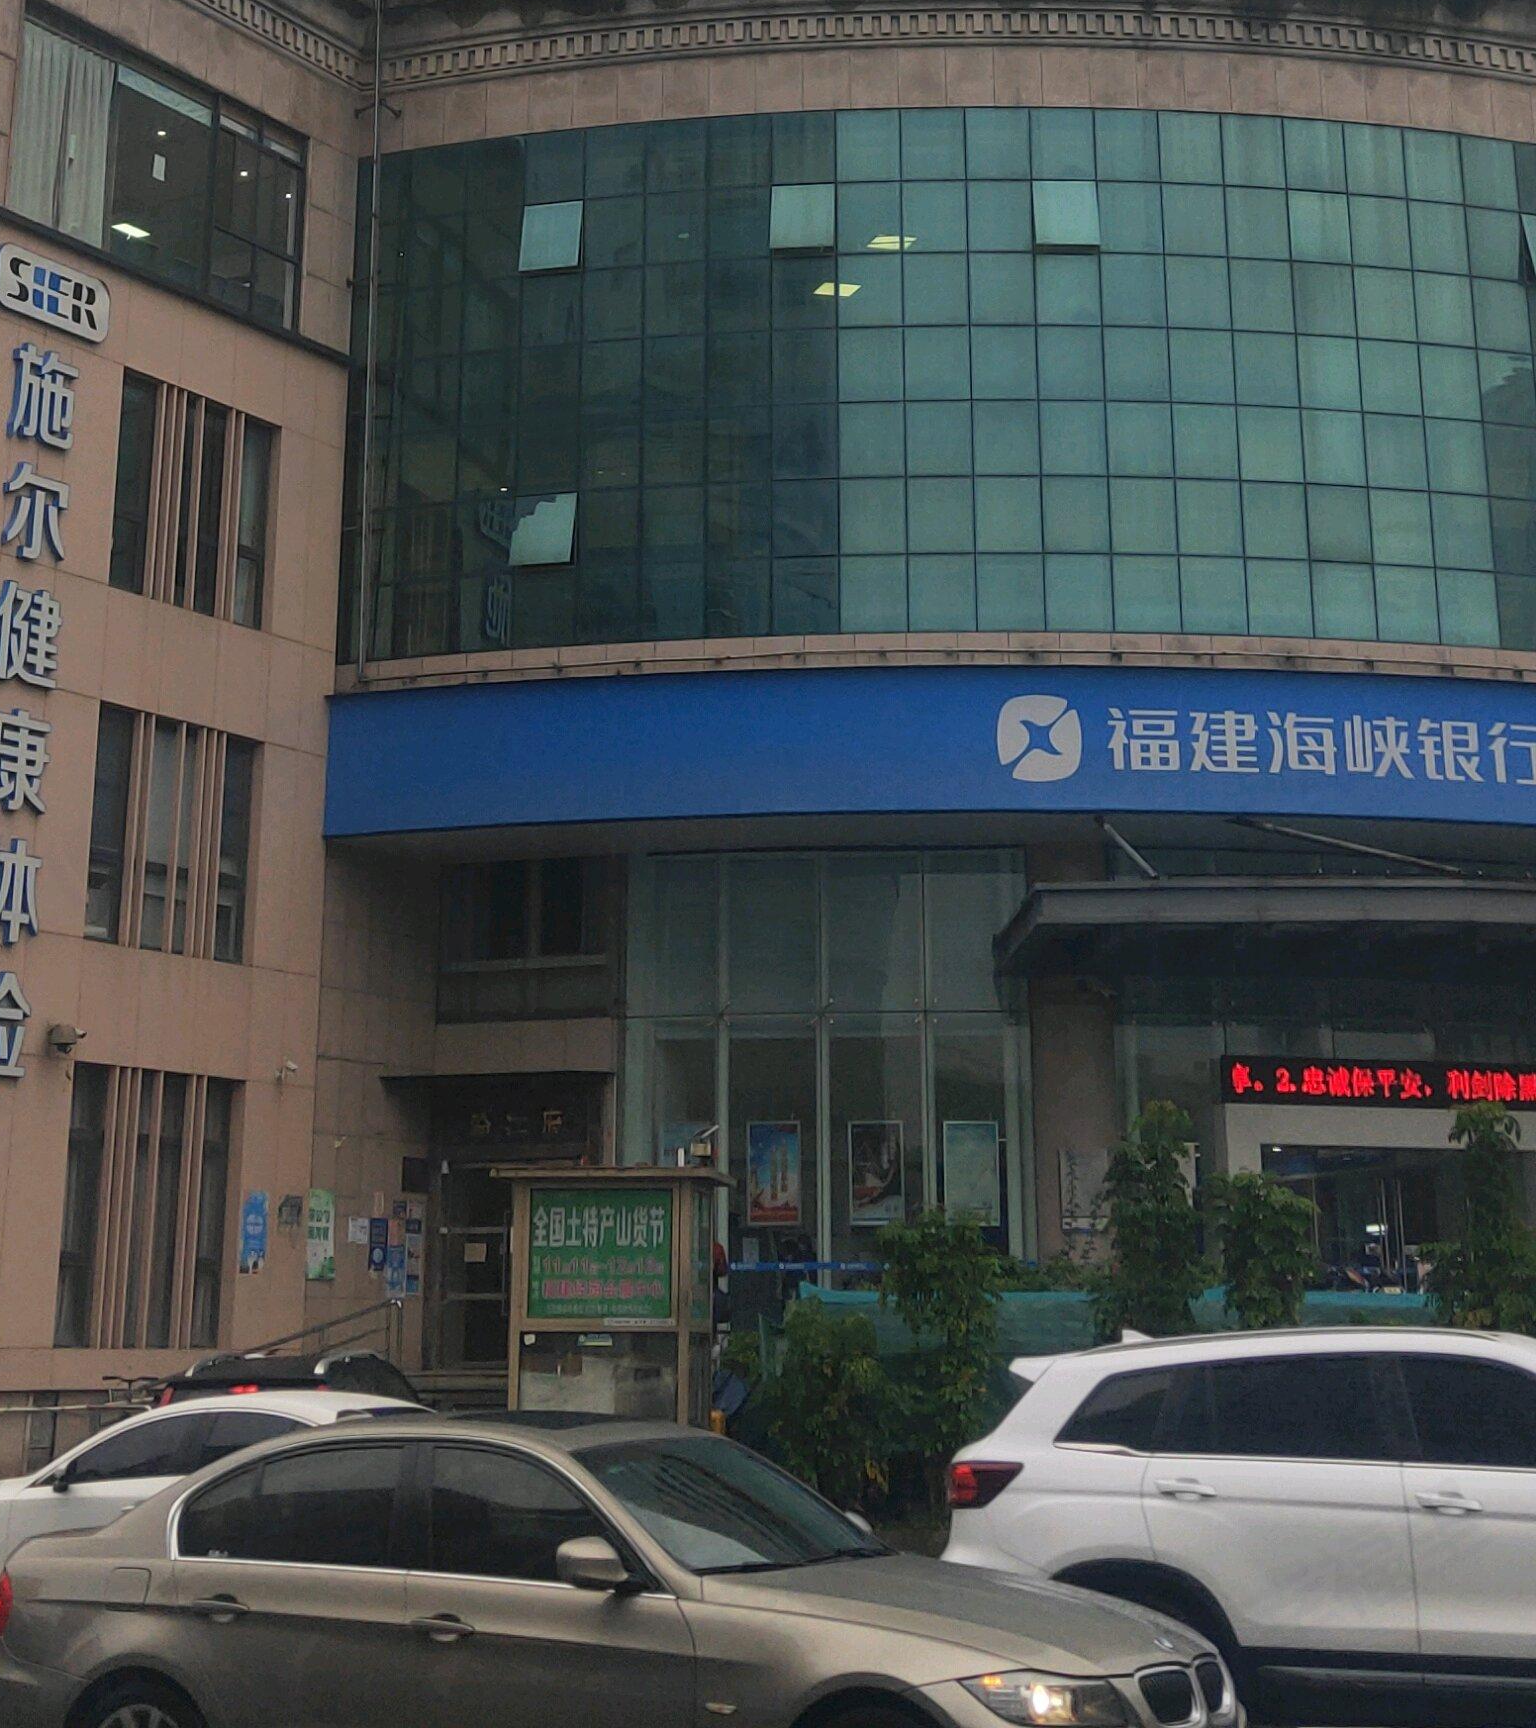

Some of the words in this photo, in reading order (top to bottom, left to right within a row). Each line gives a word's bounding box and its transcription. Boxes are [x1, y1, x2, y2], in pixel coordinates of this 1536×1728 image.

[531, 1205, 666, 1249] 全国土特产山货节
